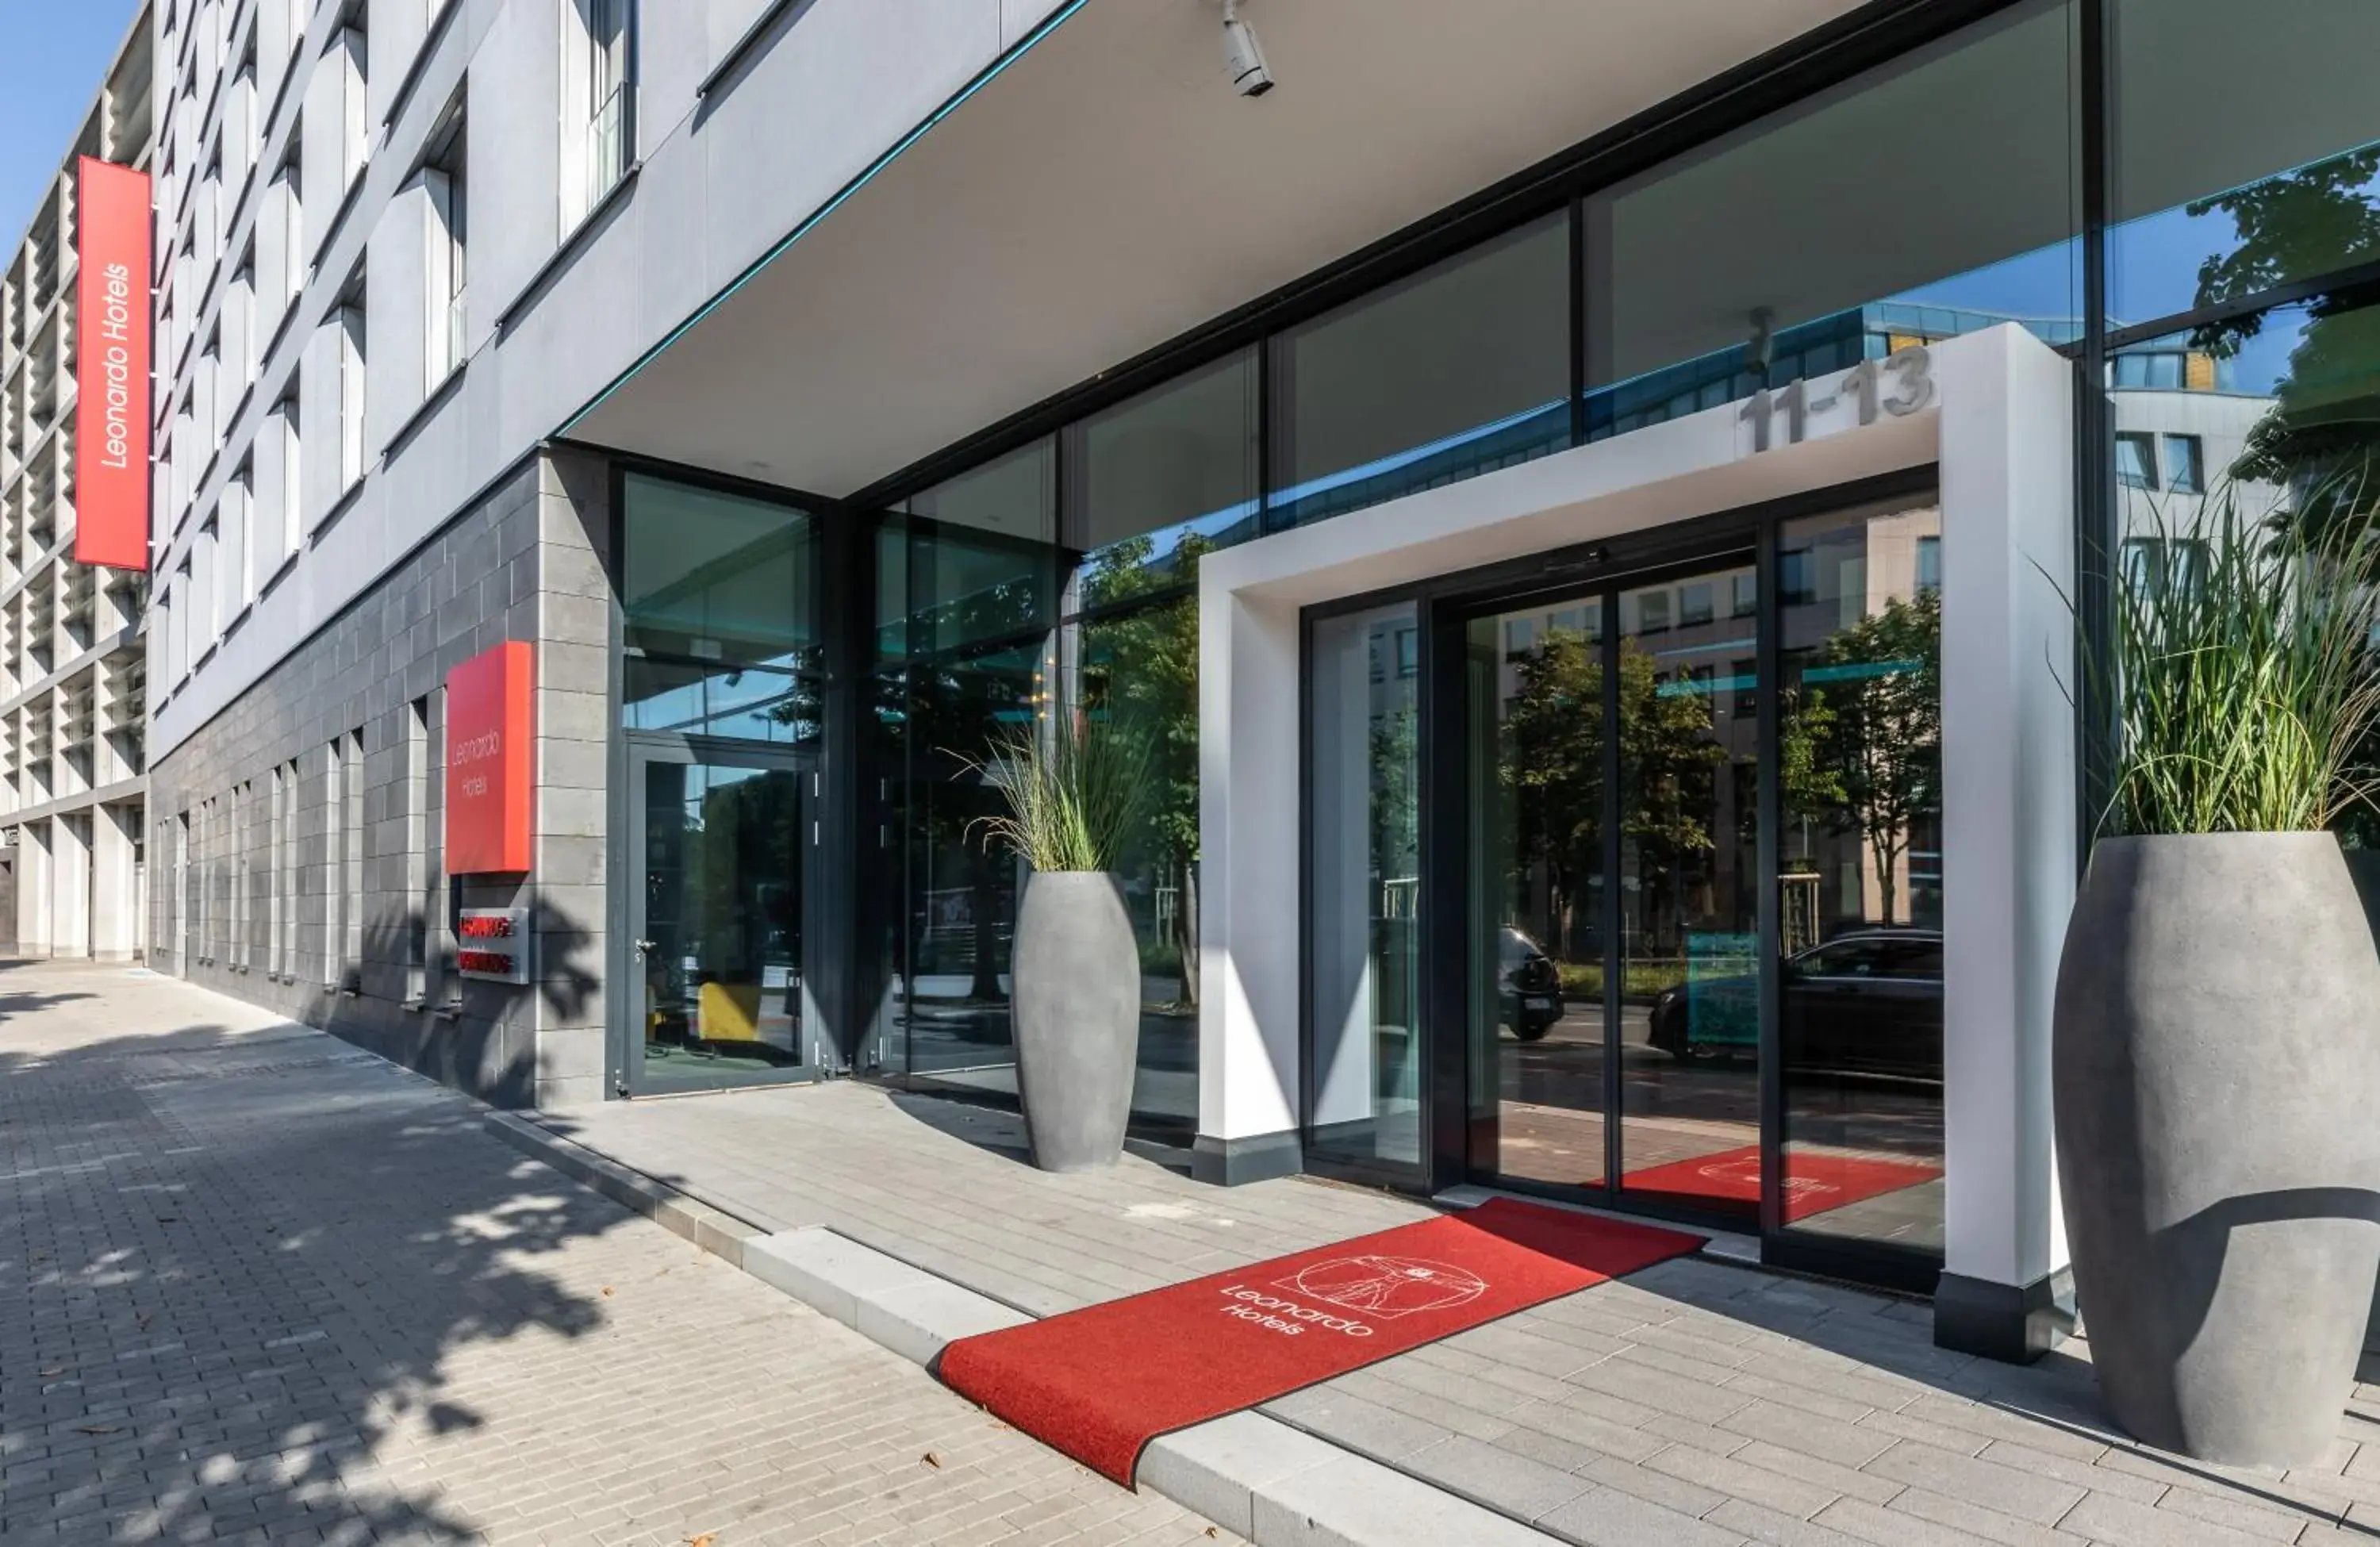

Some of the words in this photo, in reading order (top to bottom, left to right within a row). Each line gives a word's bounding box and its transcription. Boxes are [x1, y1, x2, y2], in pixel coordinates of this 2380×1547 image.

[102, 263, 129, 340] Hotels
[102, 346, 129, 468] Leonardo
[1739, 345, 1934, 452] 11-13
[453, 727, 501, 766] Leonardo
[1219, 1284, 1373, 1336] Leonardo
[1219, 1303, 1305, 1334] Hotels
